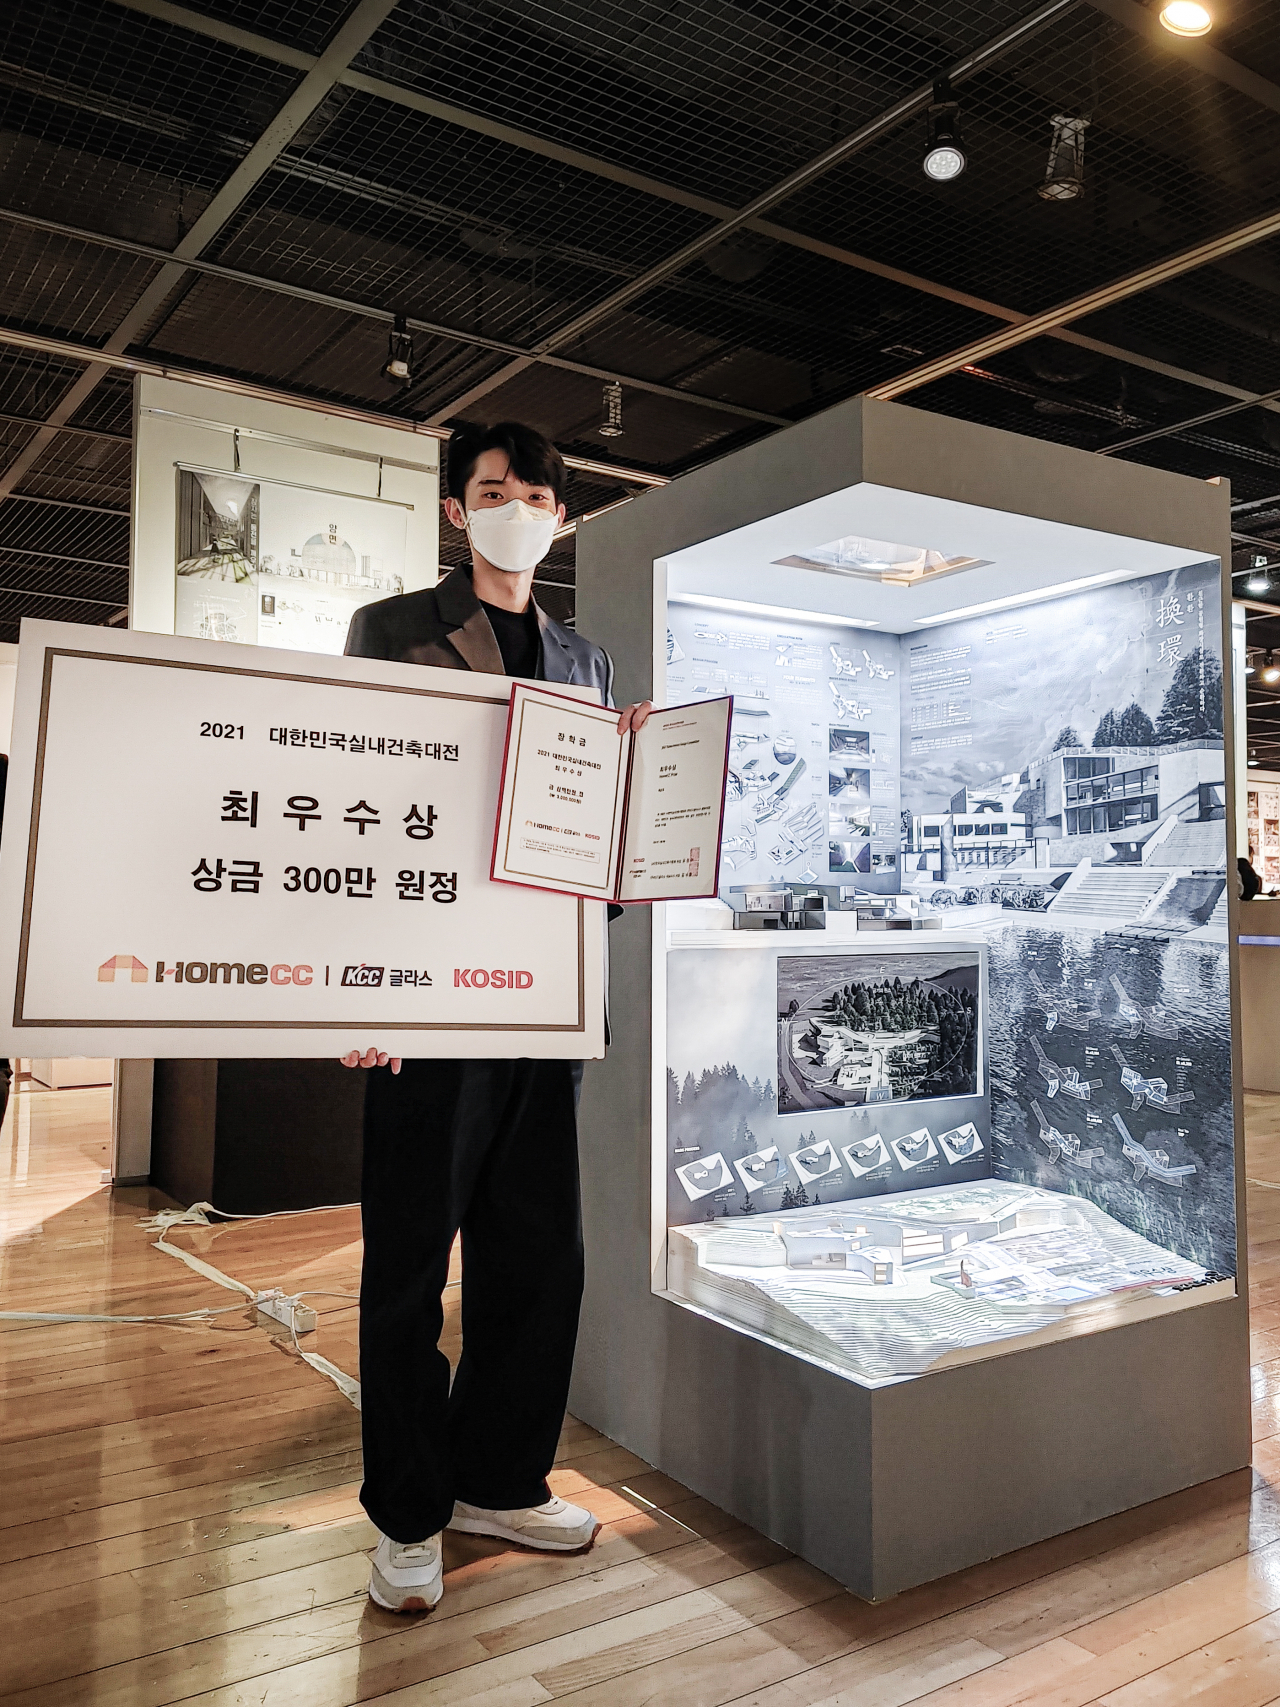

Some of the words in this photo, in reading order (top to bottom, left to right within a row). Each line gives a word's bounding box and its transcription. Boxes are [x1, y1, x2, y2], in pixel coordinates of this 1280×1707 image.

[1155, 595, 1185, 668] 換環
[200, 721, 245, 740] 2021
[269, 726, 460, 762] 대한민국실내건축대전
[190, 857, 264, 894] 상금
[283, 865, 377, 899] 300만
[394, 868, 459, 904] 원정
[343, 963, 384, 987] KCC
[389, 969, 433, 988] 글라스
[453, 968, 534, 990] KOSID
[879, 966, 886, 975] E
